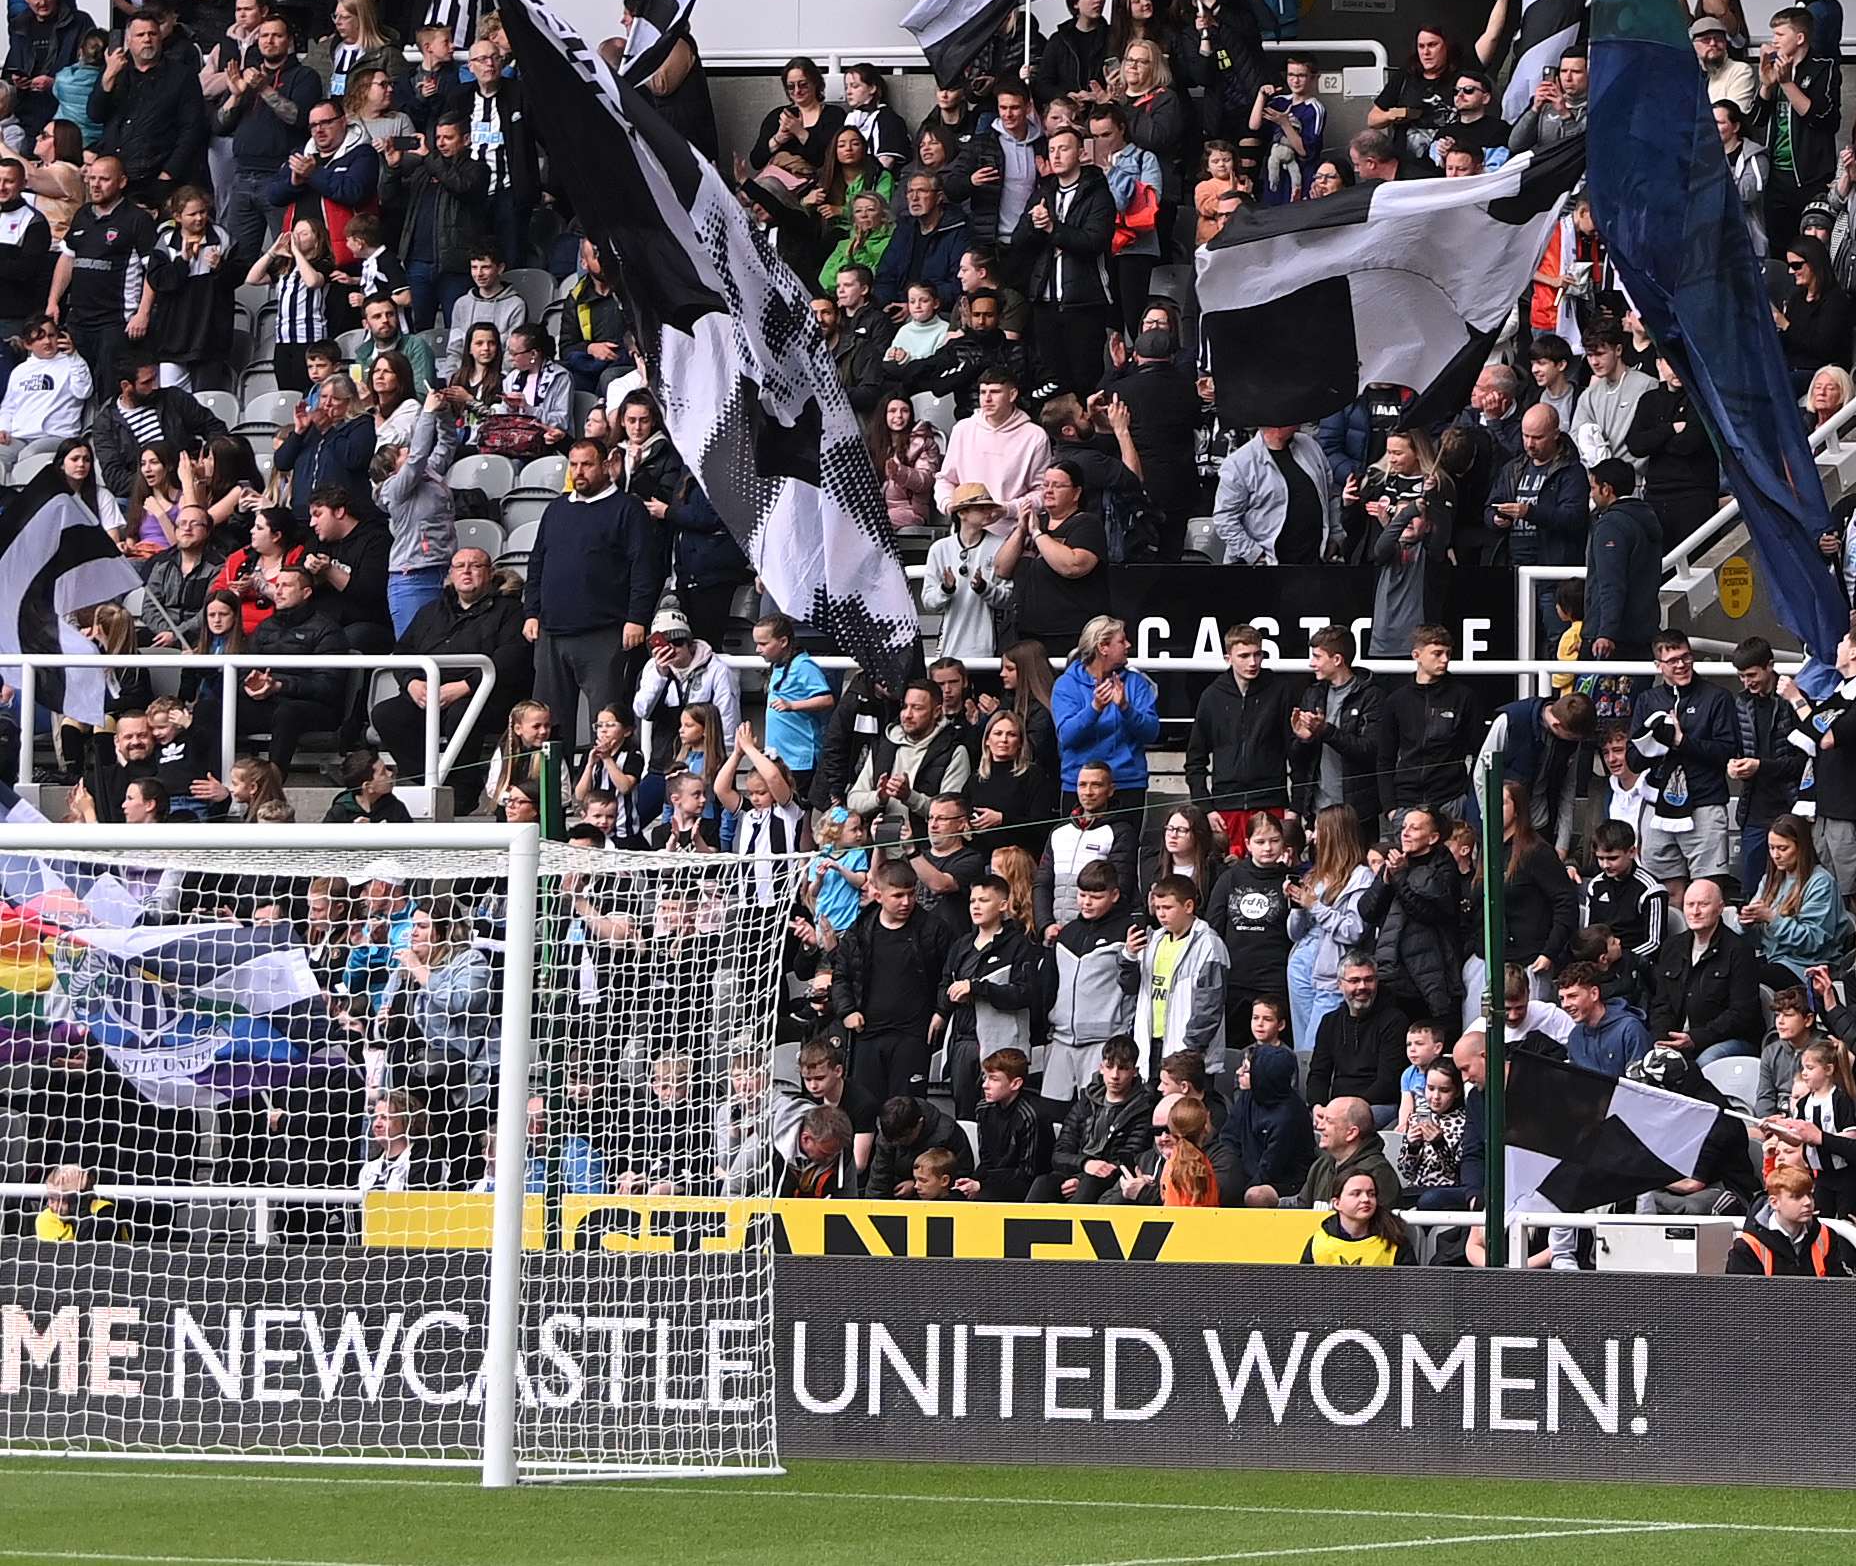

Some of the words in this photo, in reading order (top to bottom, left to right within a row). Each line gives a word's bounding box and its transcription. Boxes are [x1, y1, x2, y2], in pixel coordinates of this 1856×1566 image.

[1324, 76, 1338, 90] 62
[793, 1321, 1174, 1422] UNITED
[1203, 1328, 1648, 1435] WOMEN!
